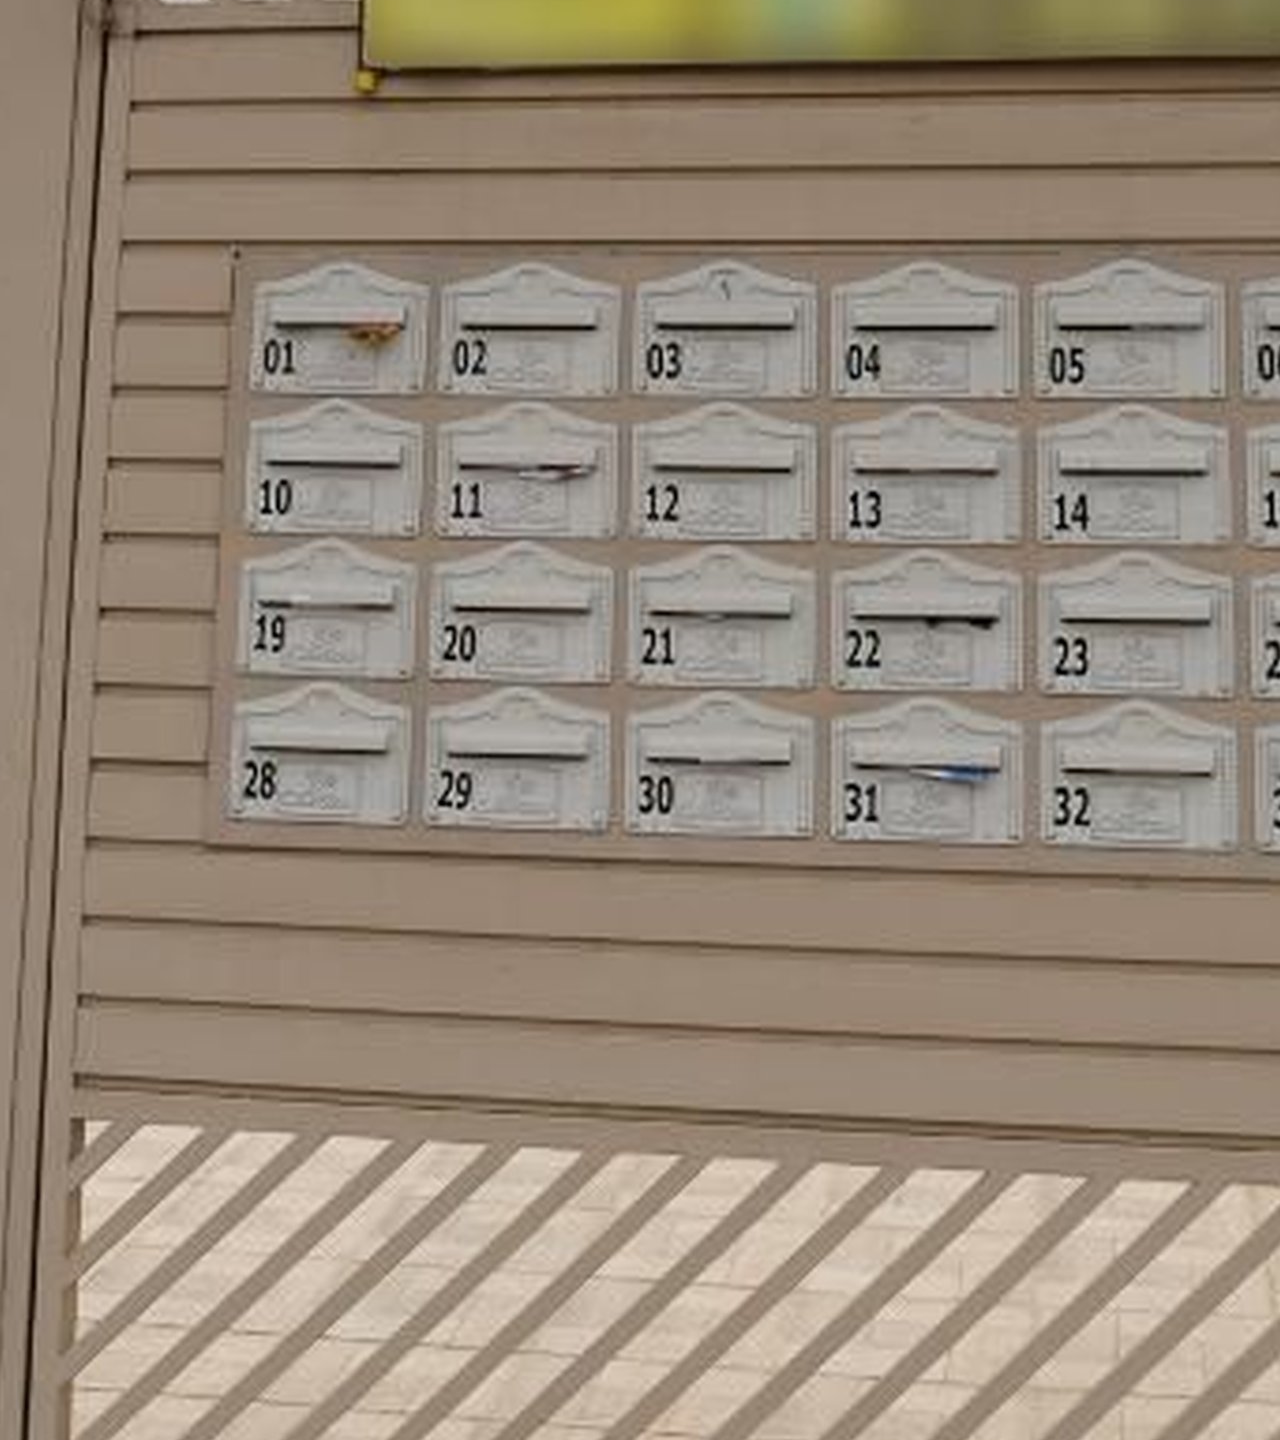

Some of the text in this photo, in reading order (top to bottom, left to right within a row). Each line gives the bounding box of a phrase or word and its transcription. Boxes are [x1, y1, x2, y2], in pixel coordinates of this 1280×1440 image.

[263, 338, 295, 375] 01
[452, 338, 487, 376] 02
[646, 341, 682, 380] 03
[845, 344, 881, 381] 04
[1048, 347, 1085, 385] 05
[260, 478, 293, 516] 10
[451, 482, 483, 519] 11
[646, 483, 679, 522] 12
[849, 490, 882, 529] 13
[1054, 493, 1090, 531] 14
[253, 614, 286, 653] 19
[442, 624, 477, 663] 20
[641, 627, 675, 665] 21
[845, 629, 881, 669] 22
[1054, 636, 1089, 677] 23
[243, 760, 277, 800] 28
[437, 769, 473, 810] 29
[638, 775, 675, 815] 30
[844, 782, 879, 823] 31
[1053, 786, 1091, 827] 32
